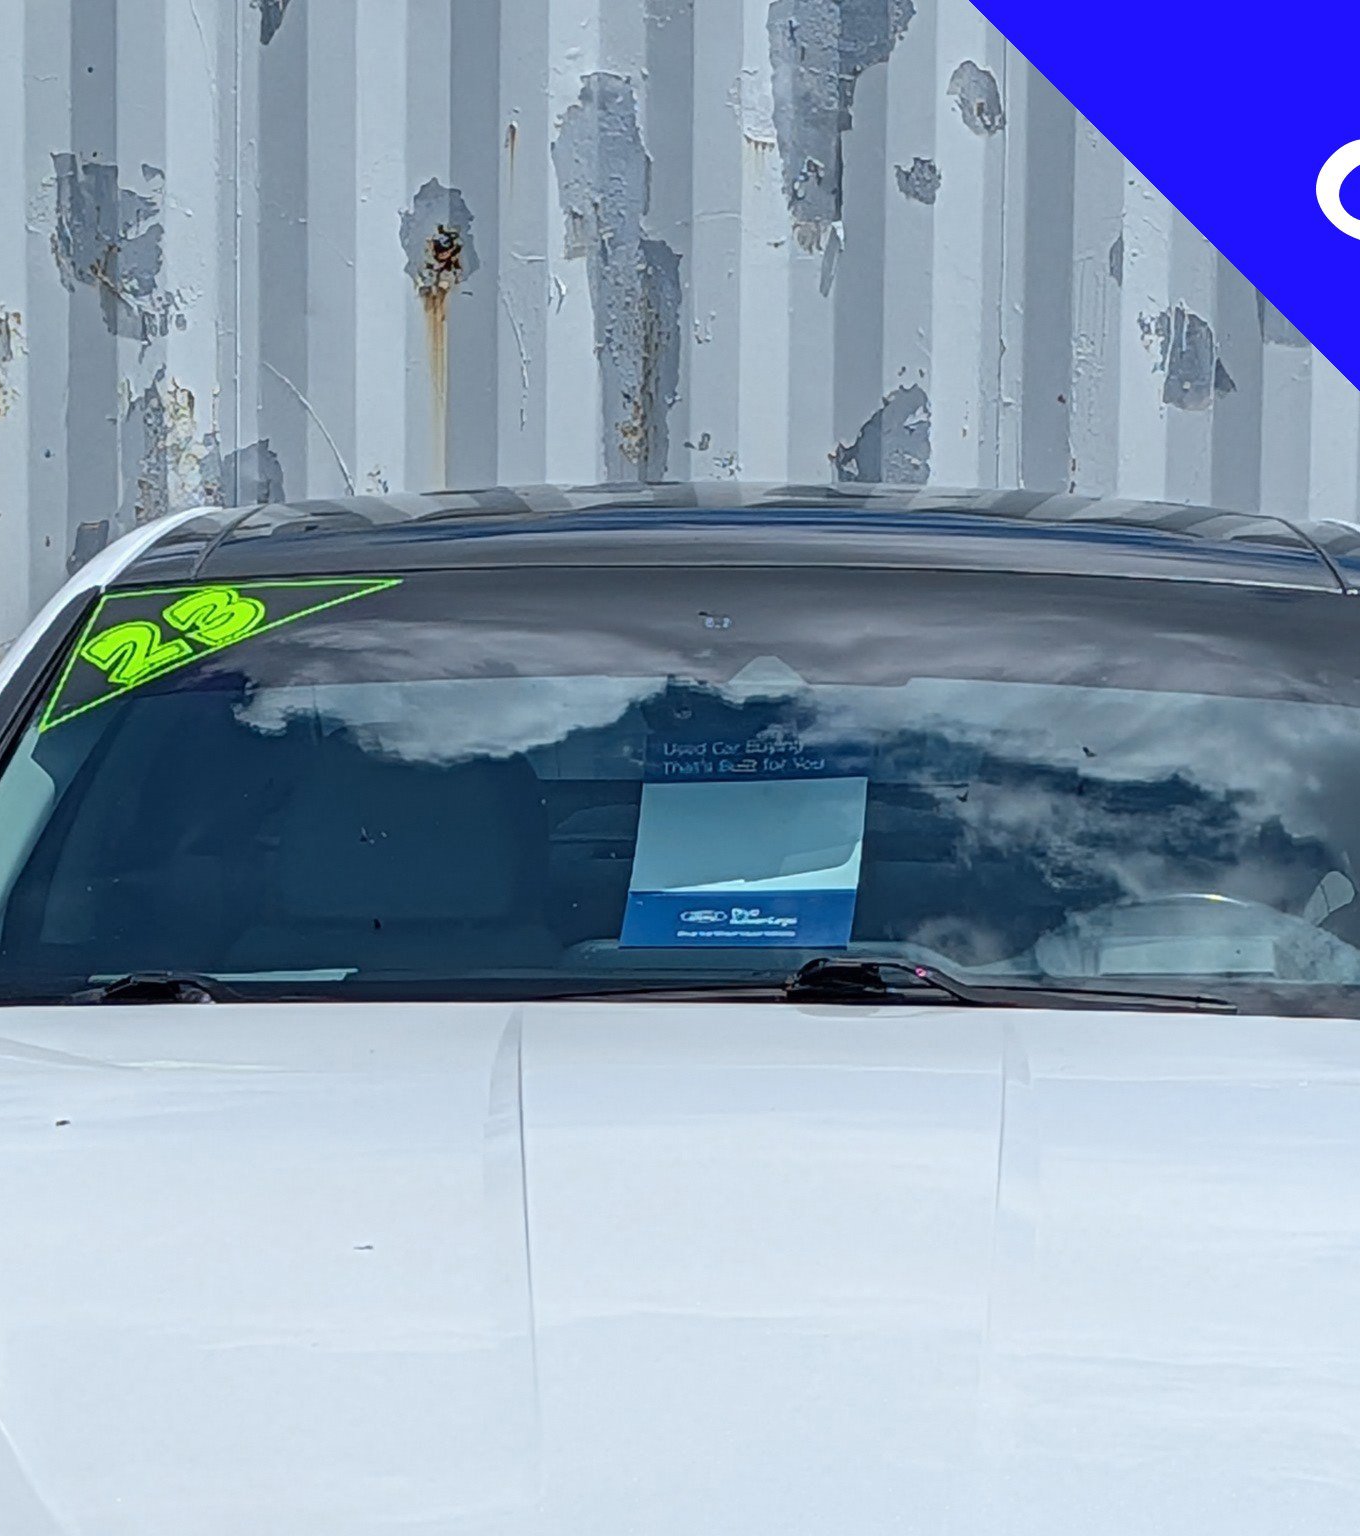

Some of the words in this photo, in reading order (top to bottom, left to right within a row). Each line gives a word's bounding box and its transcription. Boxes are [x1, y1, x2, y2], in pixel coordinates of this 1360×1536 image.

[80, 586, 266, 685] 23
[663, 742, 707, 755] Used
[712, 741, 740, 755] Car
[763, 758, 787, 770] for
